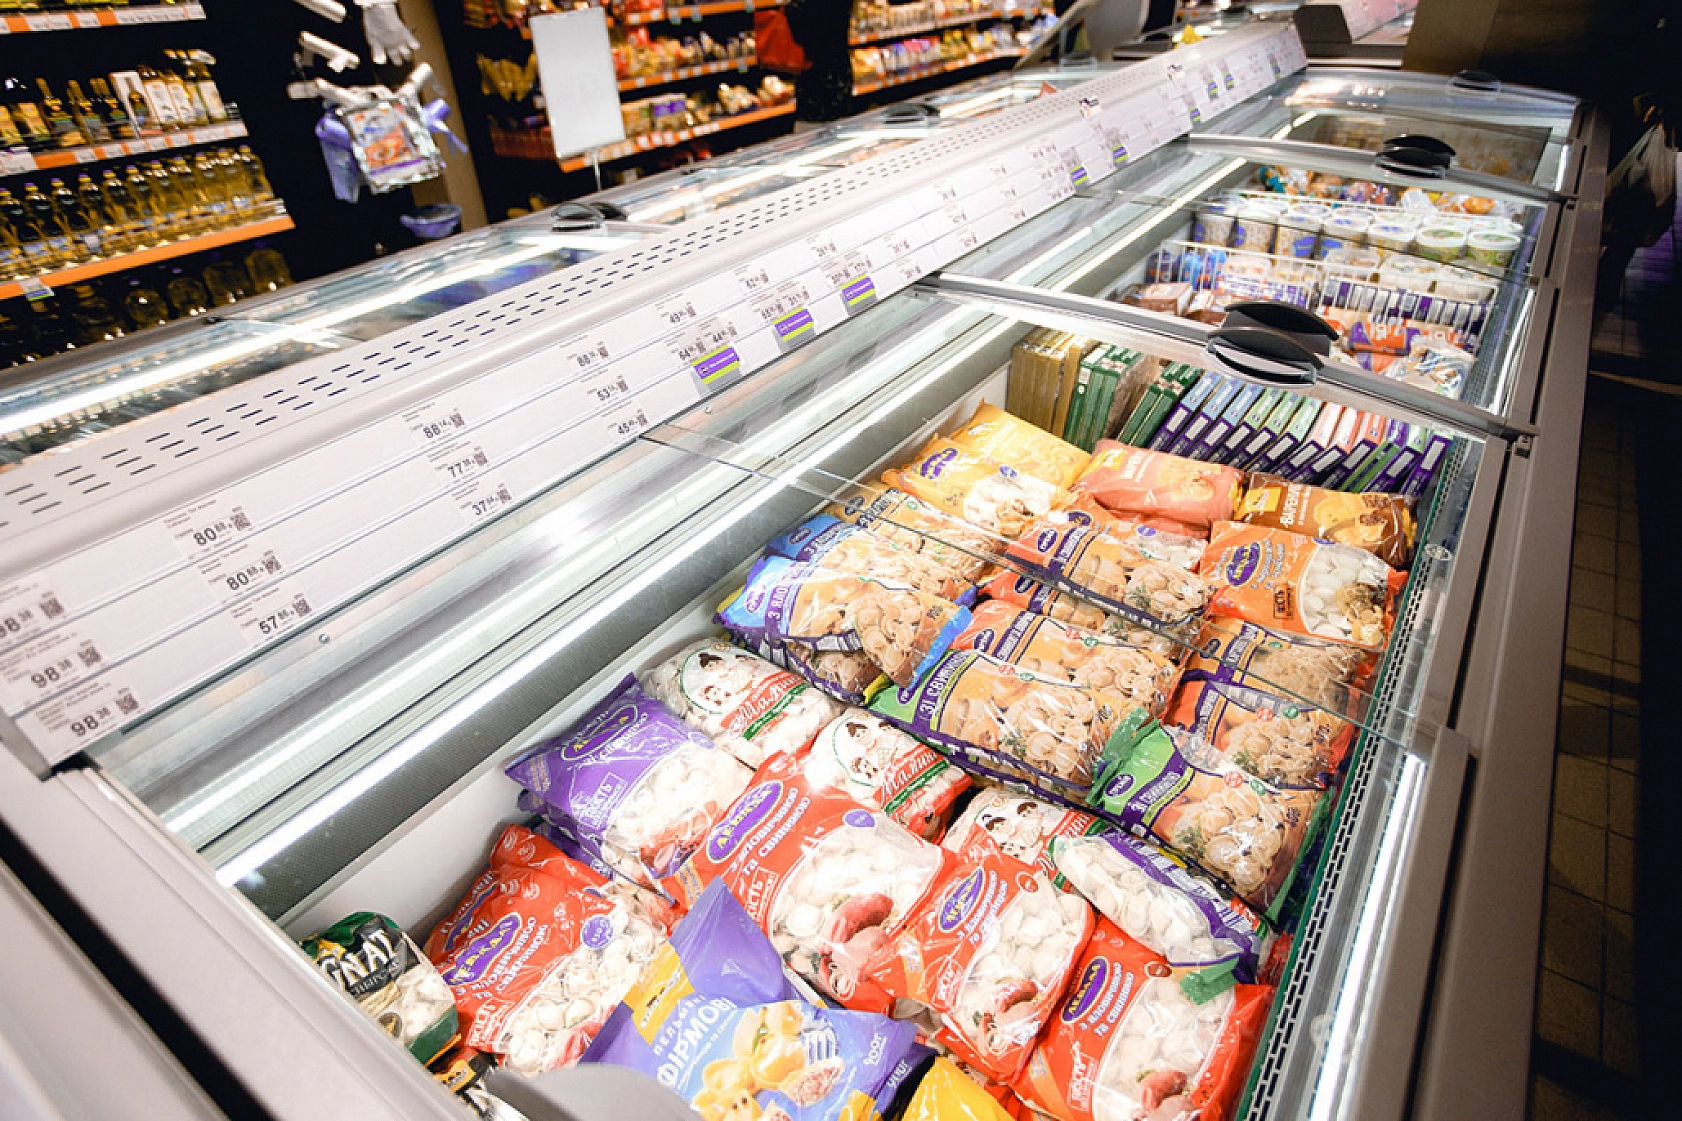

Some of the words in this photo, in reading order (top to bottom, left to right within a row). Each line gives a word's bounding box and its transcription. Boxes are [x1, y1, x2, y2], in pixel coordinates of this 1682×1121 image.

[193, 527, 217, 546] 80
[226, 571, 249, 591] 80
[259, 615, 278, 634] 57
[31, 666, 60, 688] 98
[70, 715, 98, 736] 98
